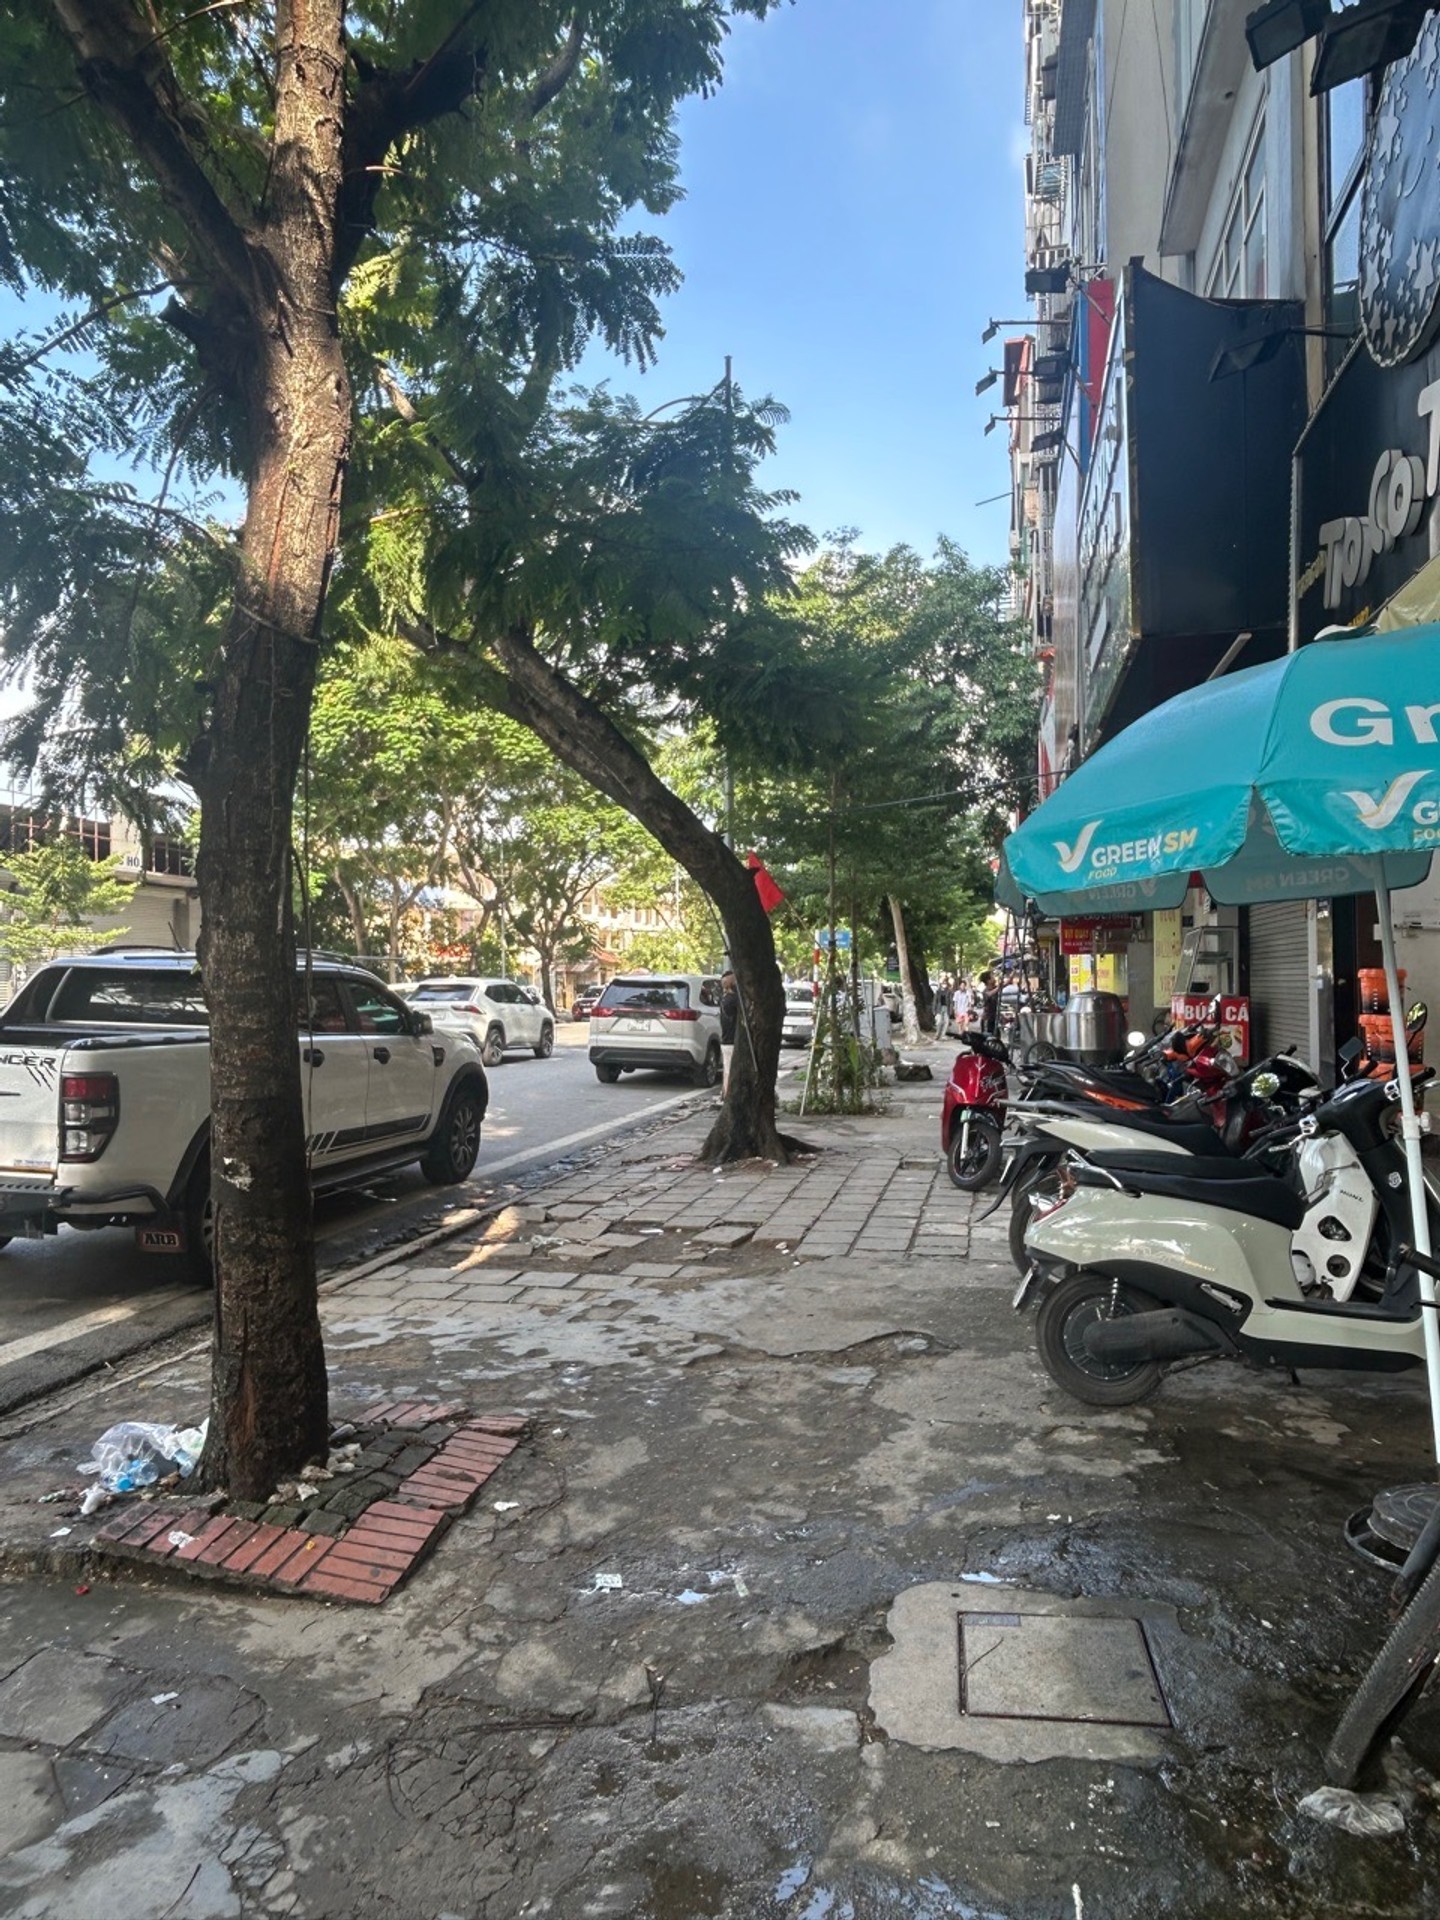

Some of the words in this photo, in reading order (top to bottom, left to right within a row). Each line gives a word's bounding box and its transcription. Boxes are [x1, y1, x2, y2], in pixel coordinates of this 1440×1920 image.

[1412, 801, 1440, 825] G
[1091, 837, 1162, 868] GREEN
[1164, 828, 1198, 853] SM
[1087, 866, 1118, 881] FOOD
[1225, 1002, 1249, 1022] CÁ
[145, 1232, 178, 1247] ARB
